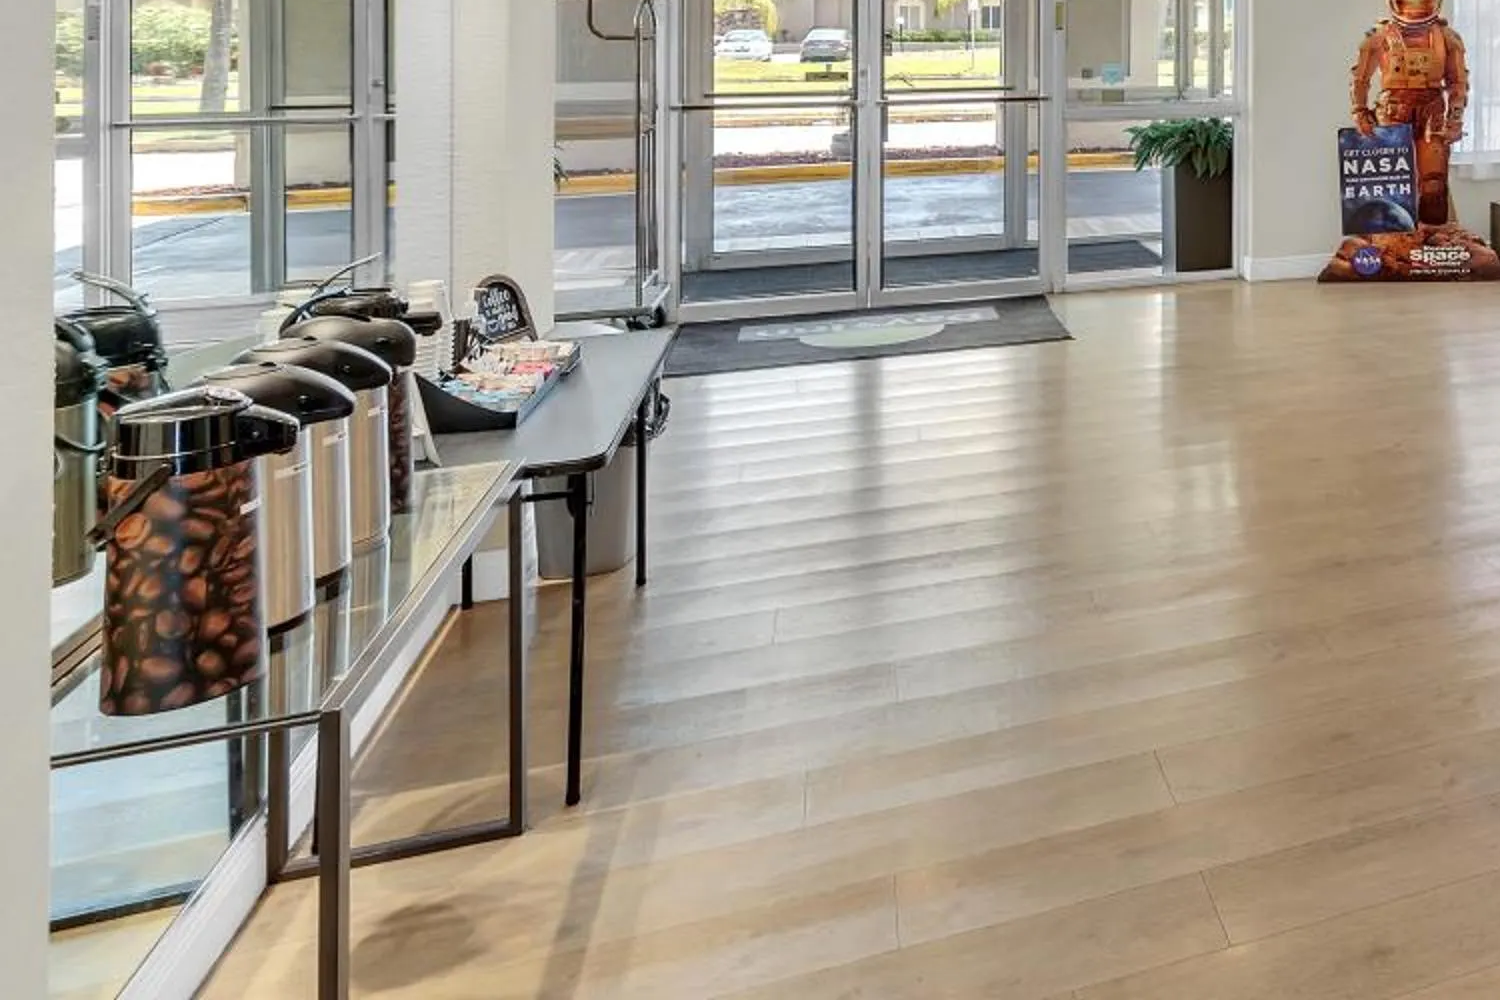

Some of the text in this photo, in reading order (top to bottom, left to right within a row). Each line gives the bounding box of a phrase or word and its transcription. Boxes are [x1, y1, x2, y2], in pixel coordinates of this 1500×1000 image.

[1343, 156, 1410, 175] NASA
[1345, 183, 1411, 199] EARTH
[1410, 249, 1470, 263] Space
